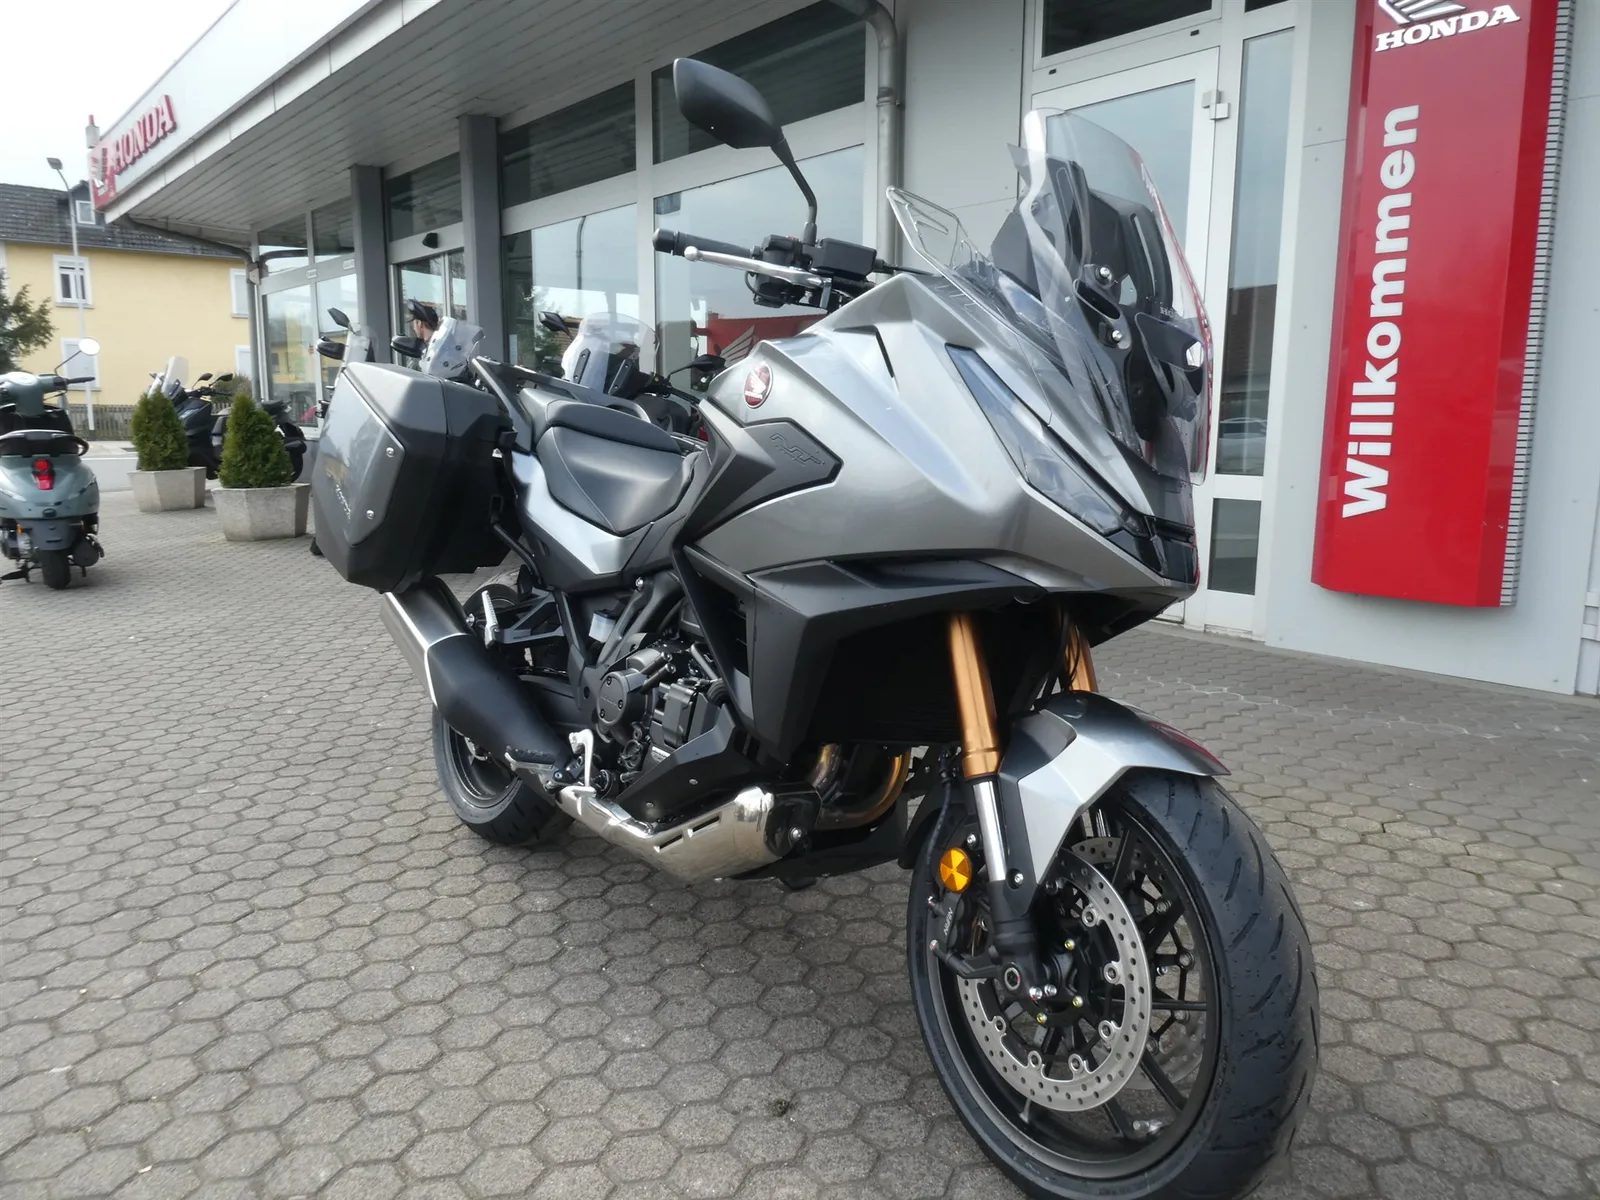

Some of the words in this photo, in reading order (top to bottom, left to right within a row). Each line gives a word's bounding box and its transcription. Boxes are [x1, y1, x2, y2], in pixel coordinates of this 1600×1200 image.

[1374, 4, 1521, 52] HONDA
[110, 94, 177, 175] HONDA
[1341, 104, 1420, 519] Willkommen
